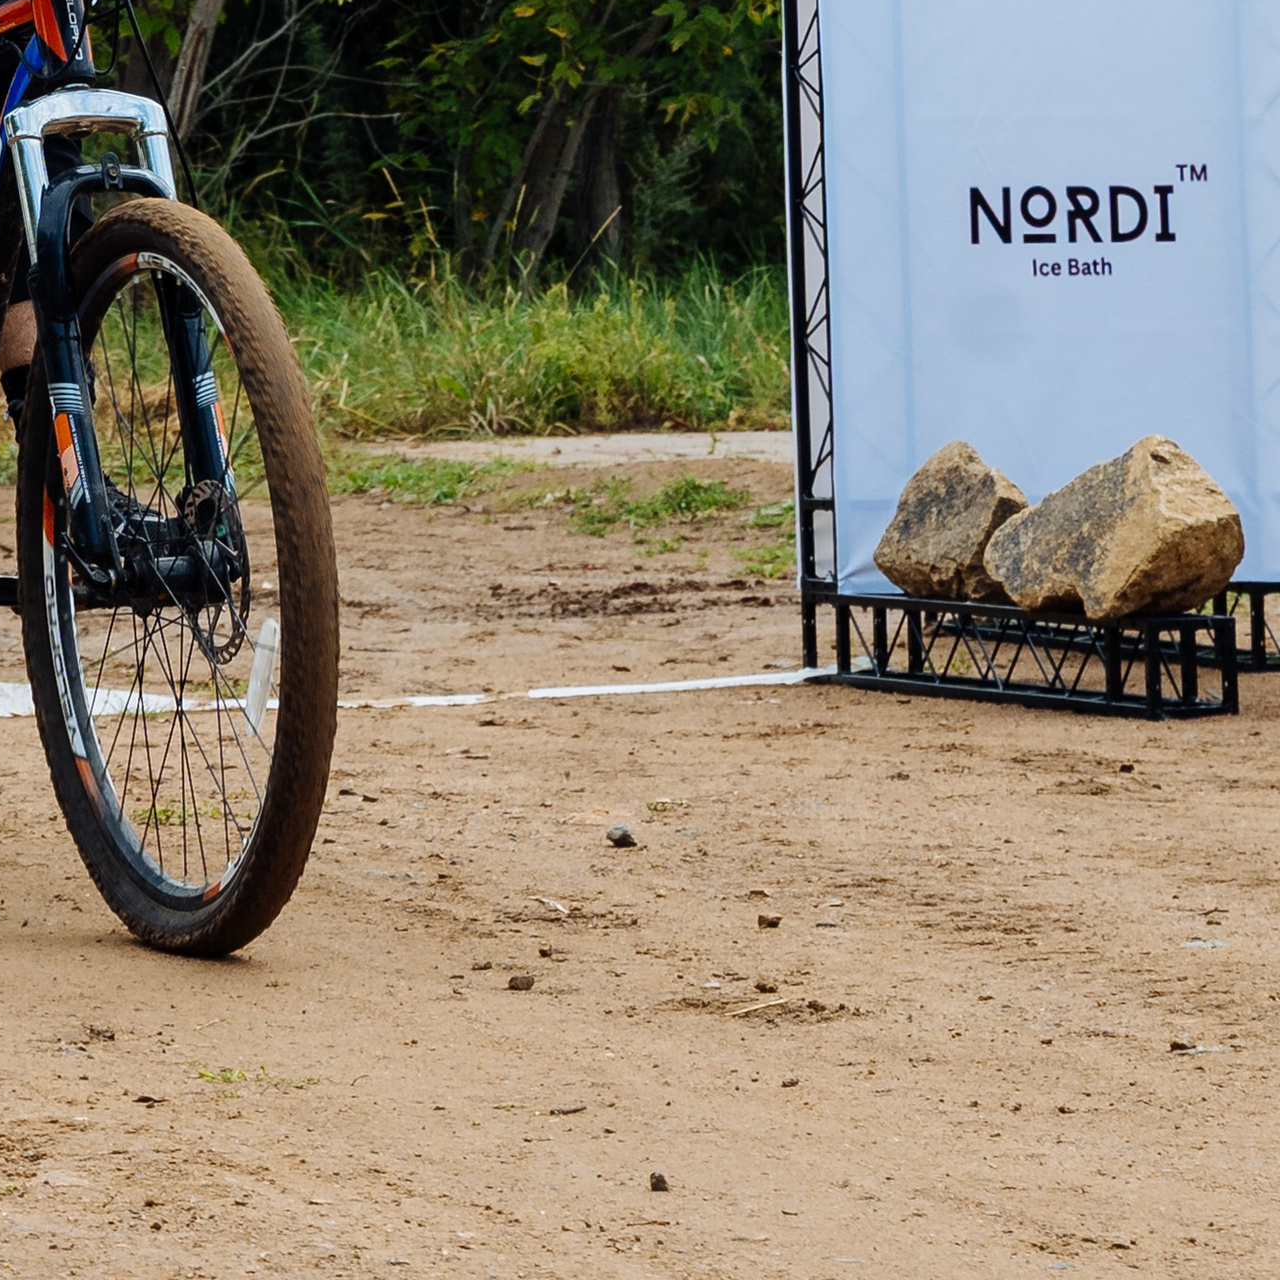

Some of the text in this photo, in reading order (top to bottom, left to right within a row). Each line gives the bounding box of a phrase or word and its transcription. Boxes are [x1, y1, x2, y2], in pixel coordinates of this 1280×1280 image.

[969, 185, 1176, 245] NORDI
[1032, 256, 1113, 277] Ice Bath
